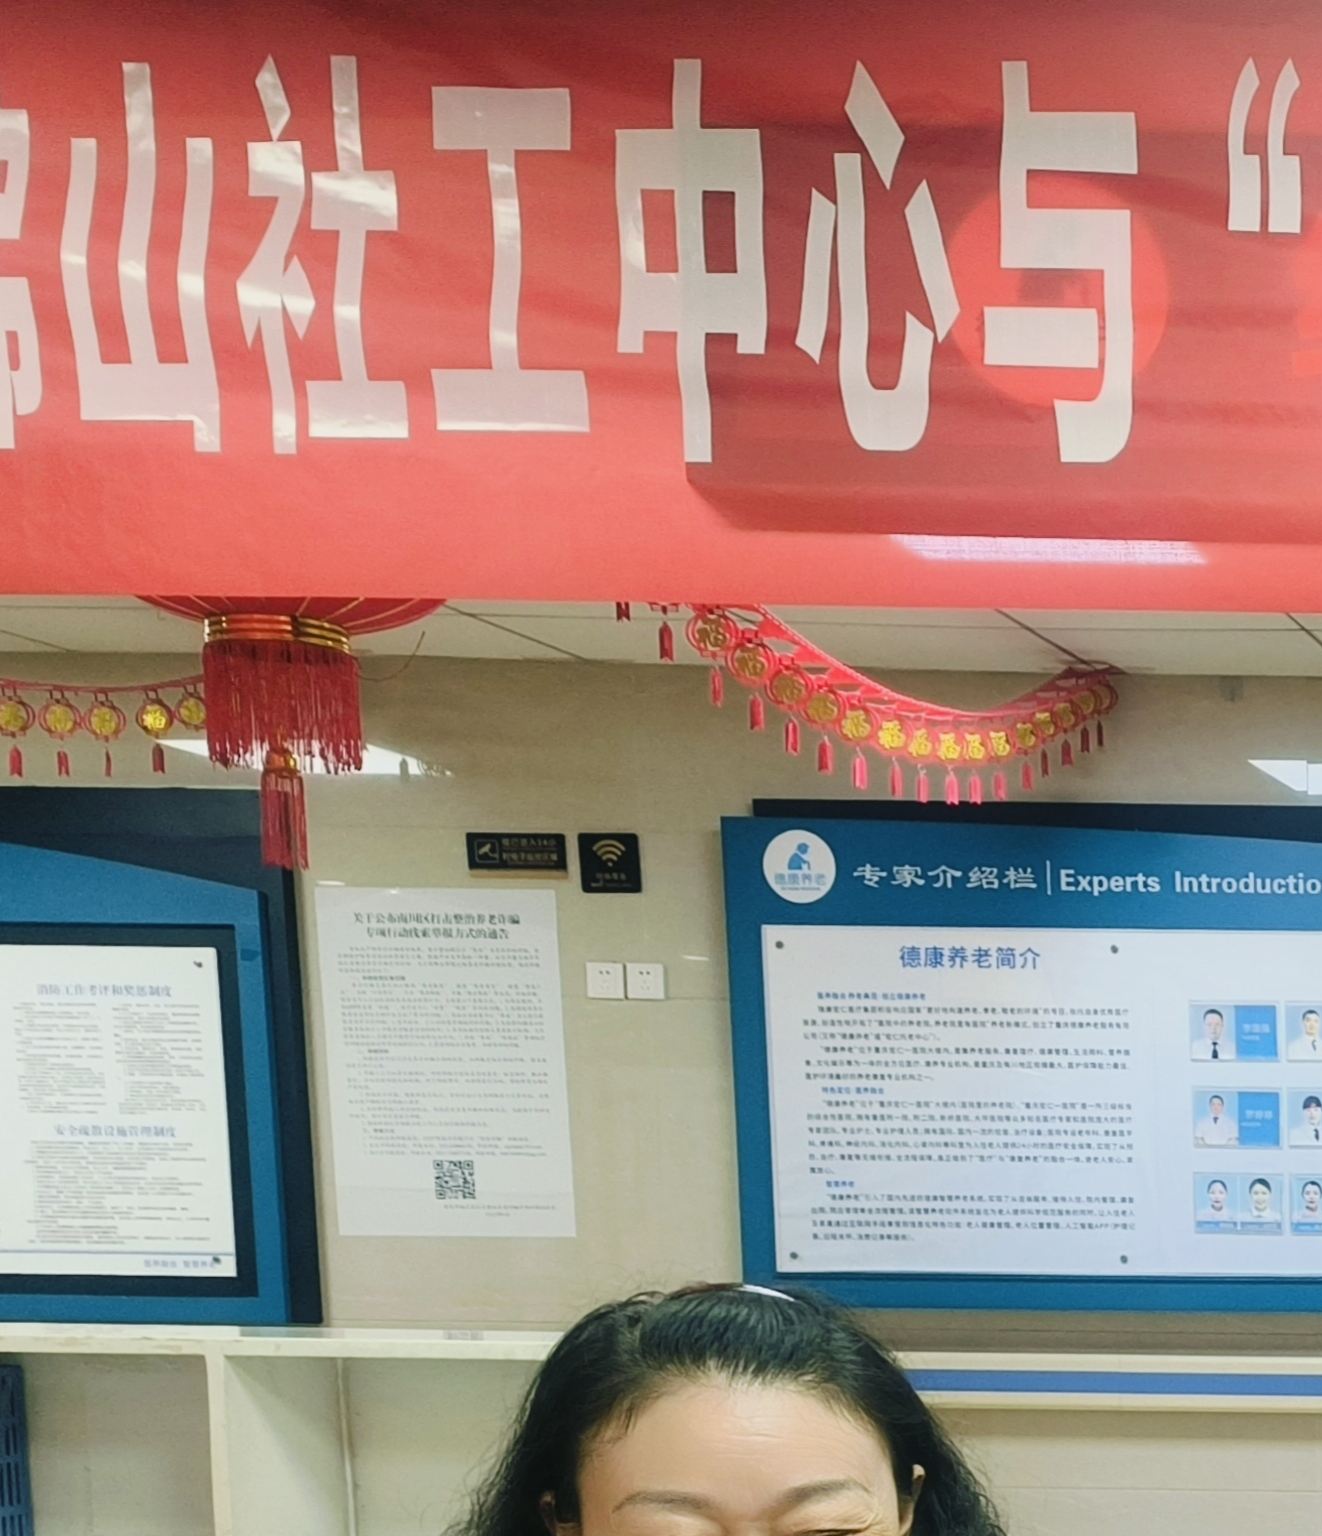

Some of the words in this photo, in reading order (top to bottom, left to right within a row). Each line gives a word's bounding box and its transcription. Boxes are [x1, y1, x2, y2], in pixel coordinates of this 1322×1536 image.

[853, 864, 1038, 890] 专家介绍栏
[1060, 869, 1161, 897] Experts
[899, 945, 1041, 970] 德康养老简介
